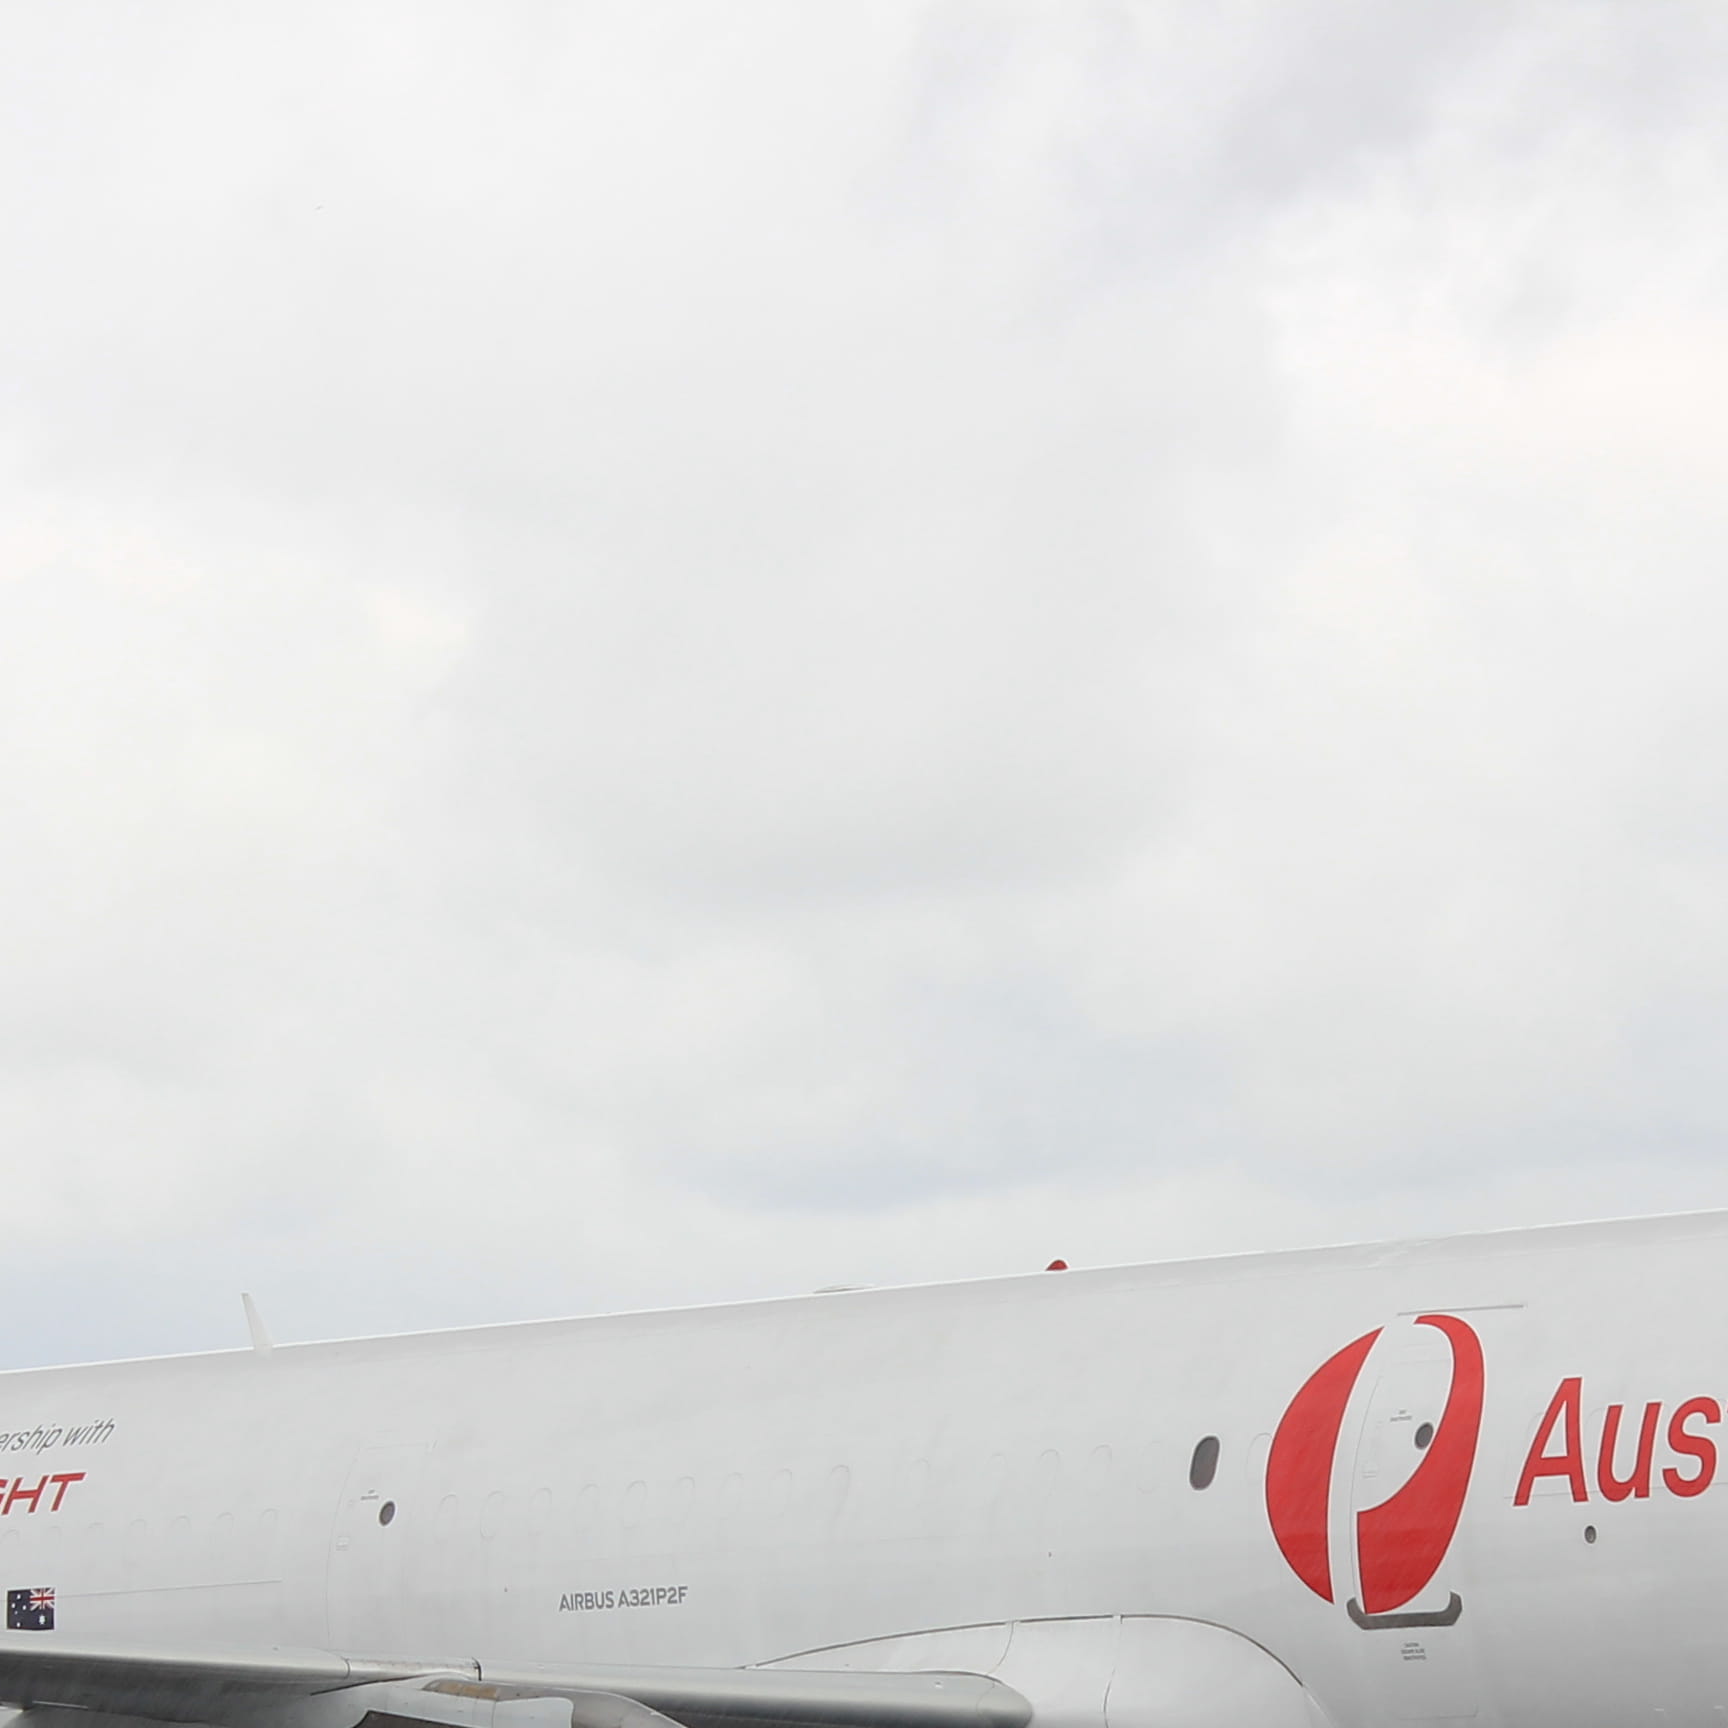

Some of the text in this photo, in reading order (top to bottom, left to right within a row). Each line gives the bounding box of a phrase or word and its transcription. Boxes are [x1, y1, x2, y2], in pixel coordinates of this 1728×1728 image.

[62, 1417, 116, 1446] with
[558, 1585, 688, 1613] AIRBUS A321P2F
